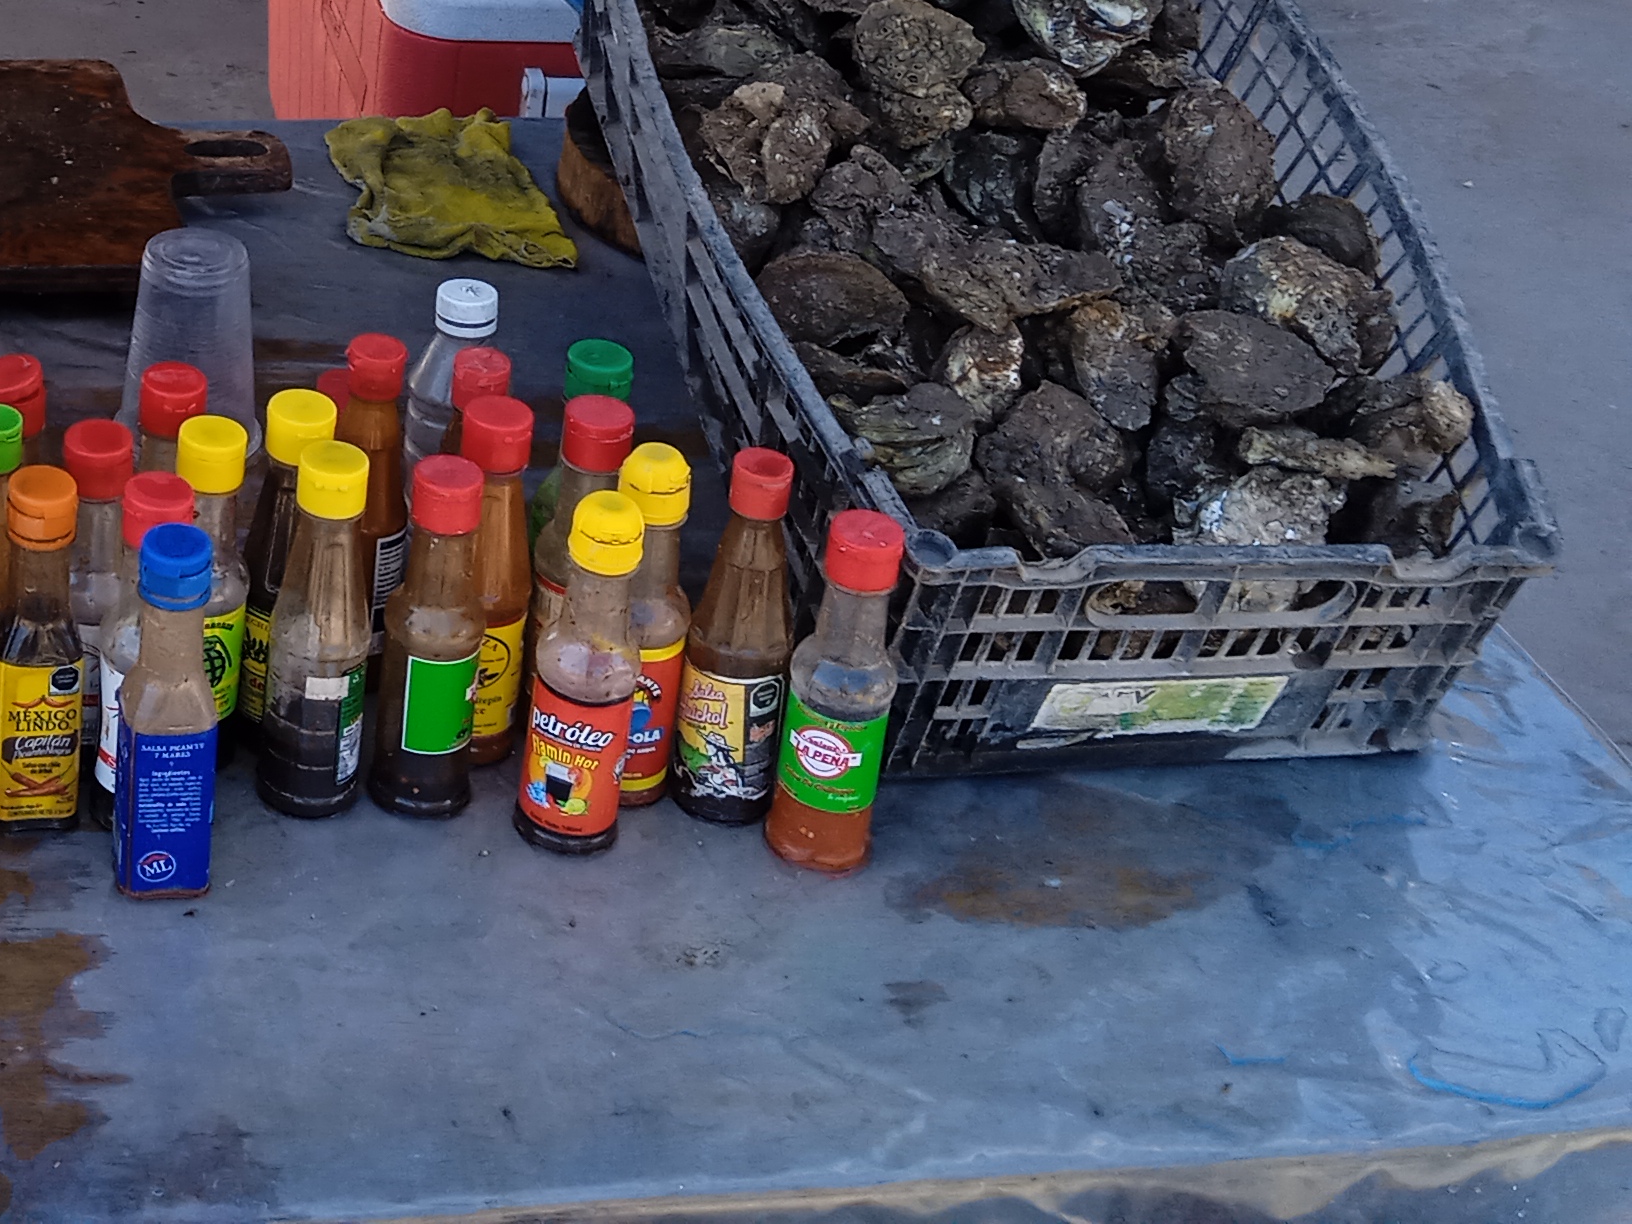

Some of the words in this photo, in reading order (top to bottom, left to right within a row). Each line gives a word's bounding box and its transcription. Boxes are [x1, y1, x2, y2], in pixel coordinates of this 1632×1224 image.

[15, 721, 69, 732] LINDO
[532, 706, 616, 748] petróleo
[14, 735, 71, 754] Capitán
[574, 755, 599, 771] Hot
[144, 860, 173, 877] ML
